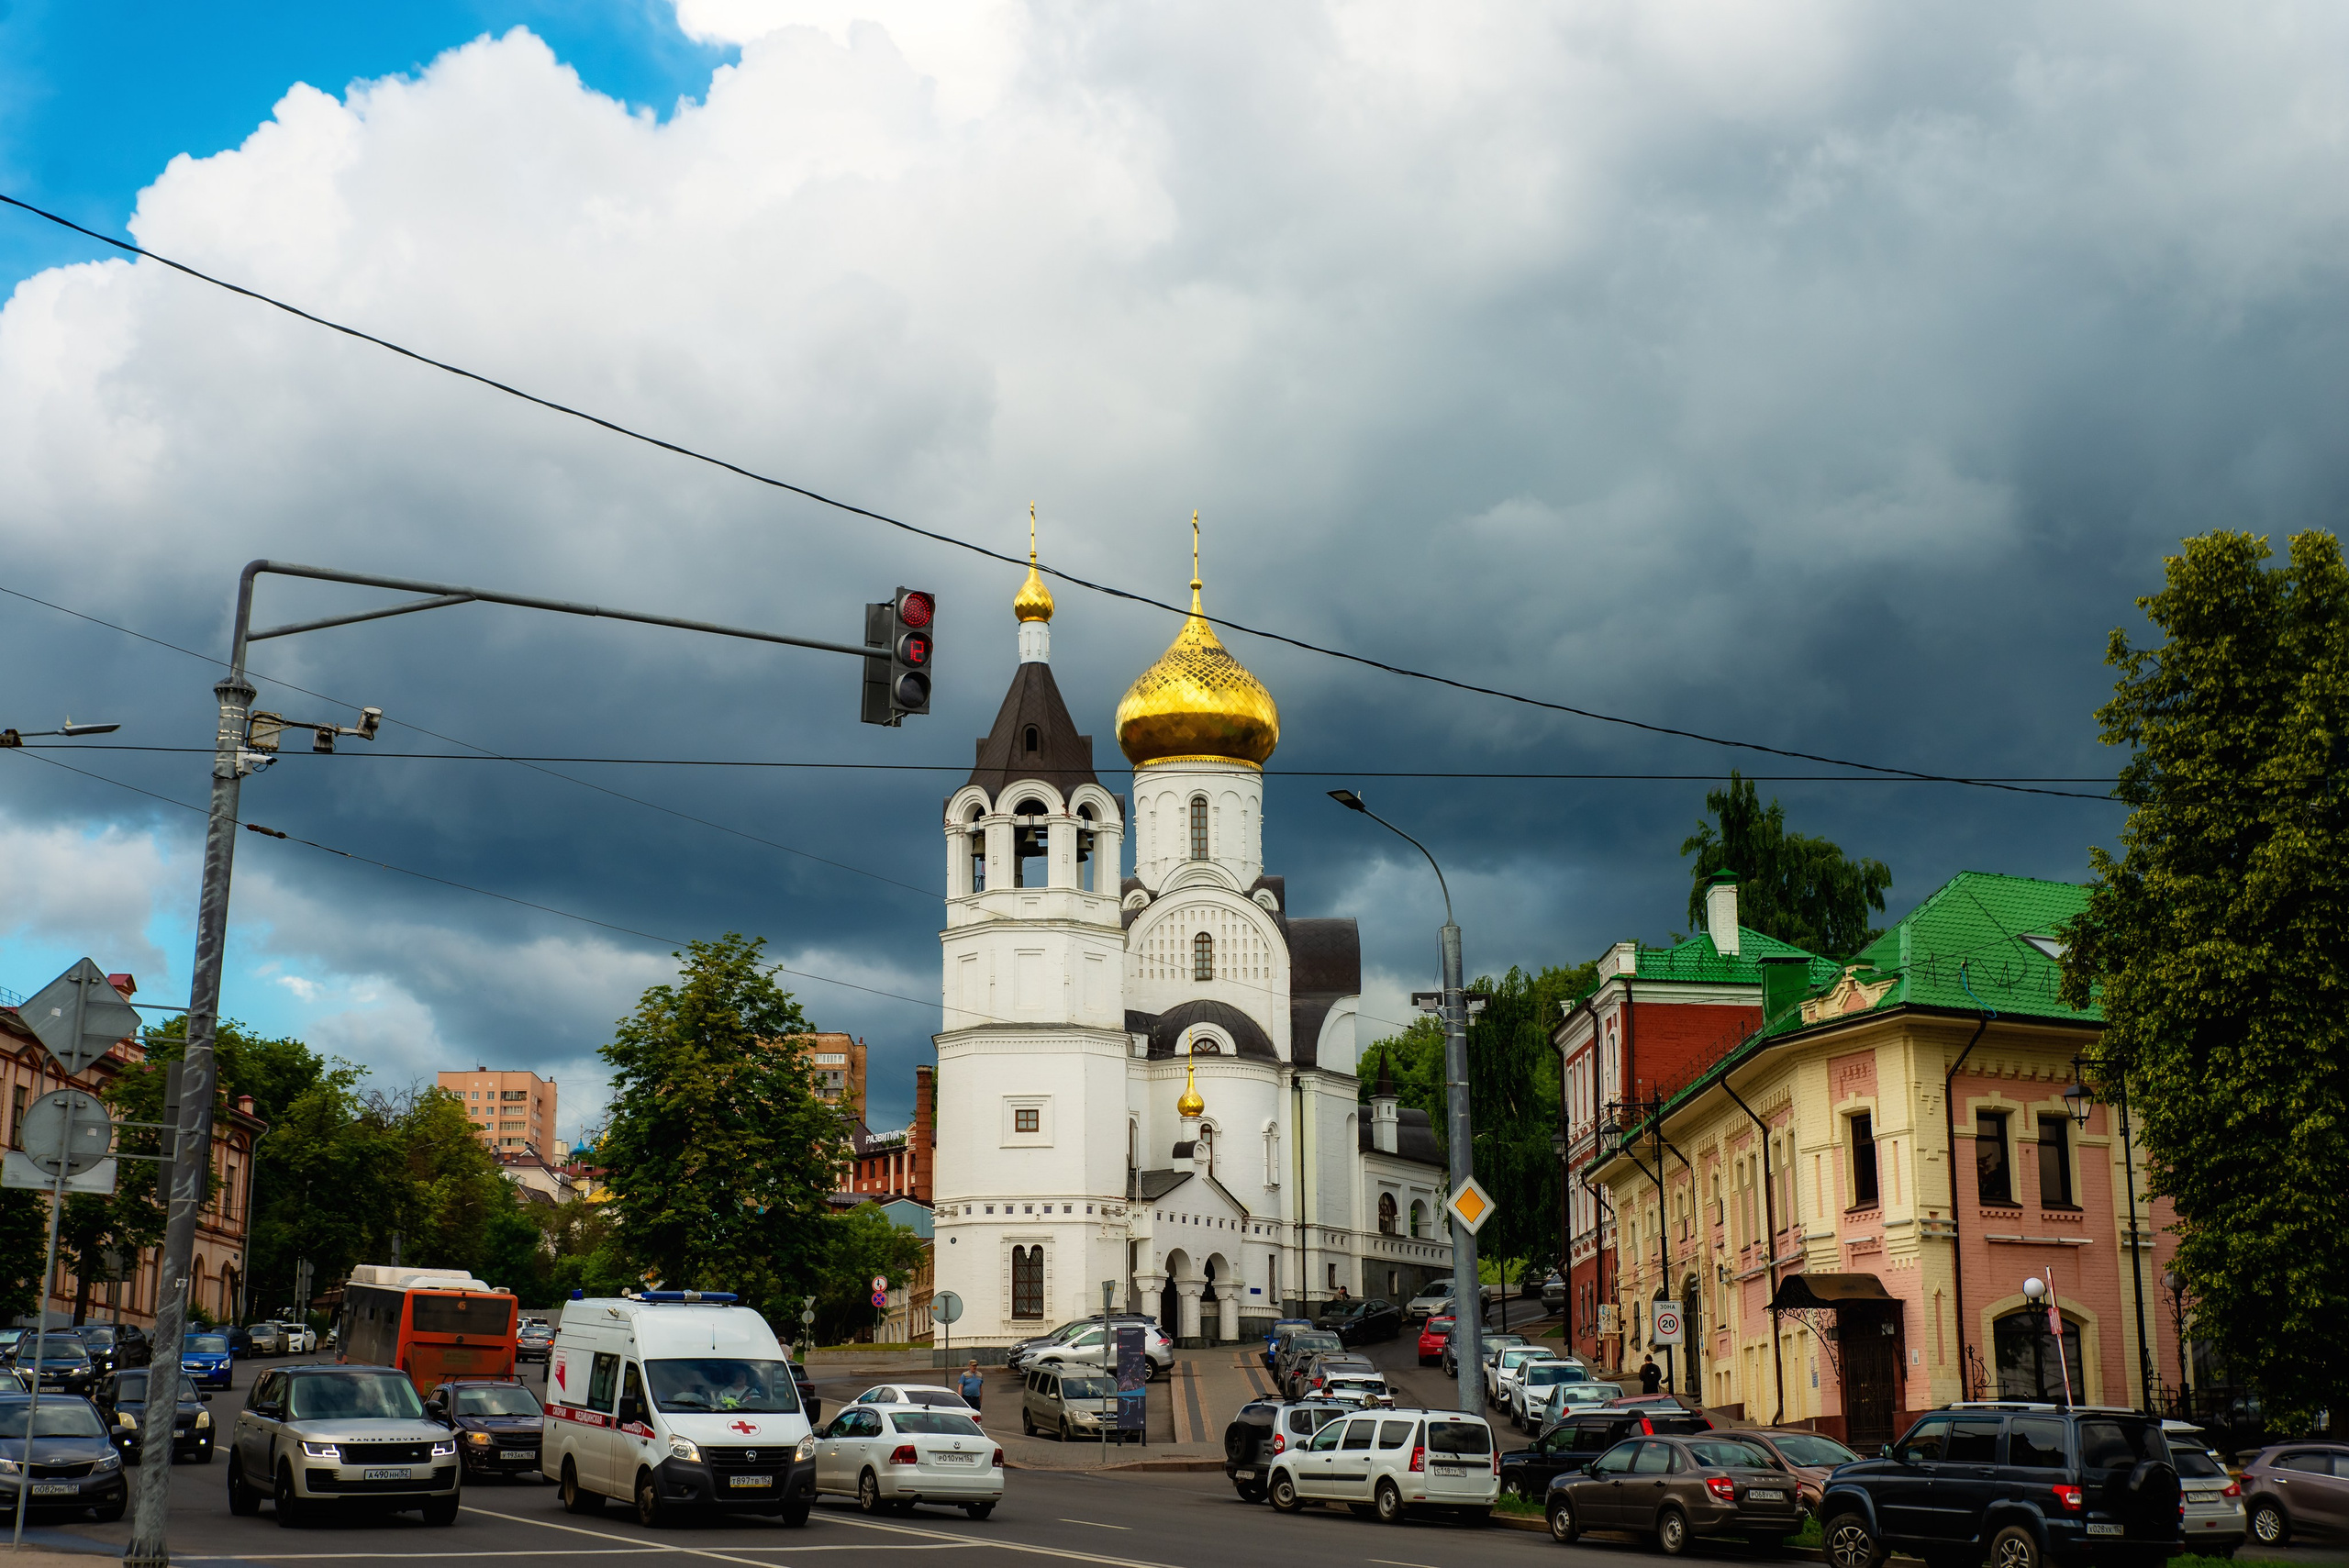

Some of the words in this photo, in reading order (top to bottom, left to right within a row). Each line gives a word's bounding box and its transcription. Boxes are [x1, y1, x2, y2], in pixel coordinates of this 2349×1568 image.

[910, 641, 924, 662] 12
[865, 1129, 899, 1144] РАЗВИТИЯ
[458, 1301, 466, 1310] 45
[1662, 1319, 1675, 1329] 20
[552, 1406, 566, 1418] СКОРАЯ
[575, 1410, 602, 1425] МЕДИЦИНСКАЯ
